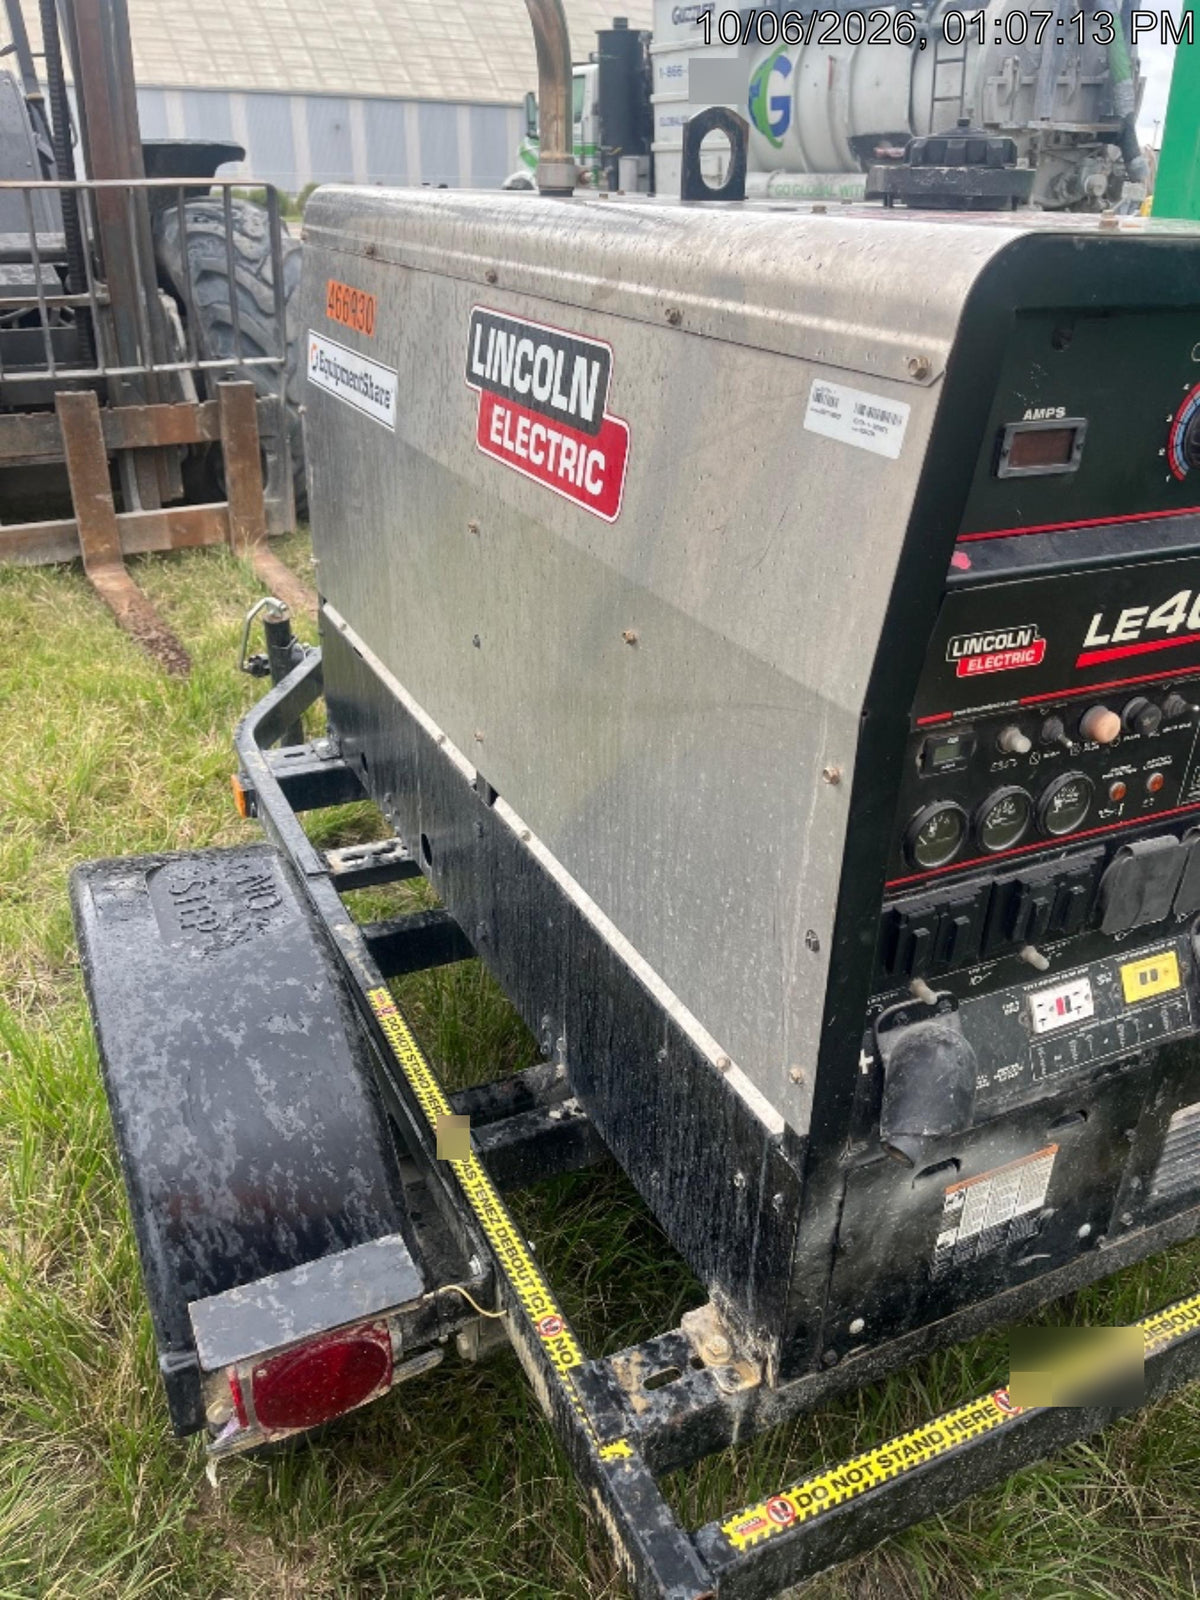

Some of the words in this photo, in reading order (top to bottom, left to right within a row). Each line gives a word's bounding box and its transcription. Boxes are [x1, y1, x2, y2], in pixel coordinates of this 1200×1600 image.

[319, 349, 392, 410] EquipmentShare
[471, 322, 601, 422] LINCOLN
[1022, 406, 1066, 421] AMPS
[490, 403, 606, 496] ELECTRIC
[952, 629, 1033, 657] LINCOLN
[966, 649, 1036, 673] ELECTRIC
[395, 1032, 412, 1054] NOT
[406, 1053, 431, 1089] STAND
[473, 1183, 502, 1225] TENEZ
[495, 1225, 535, 1288] DEBOUT
[529, 1286, 548, 1314] ICI
[552, 1336, 575, 1365] NO
[794, 1485, 830, 1509] DO
[830, 1461, 875, 1492] NOT
[875, 1429, 945, 1470] STAND
[943, 1403, 1000, 1437] HERE
